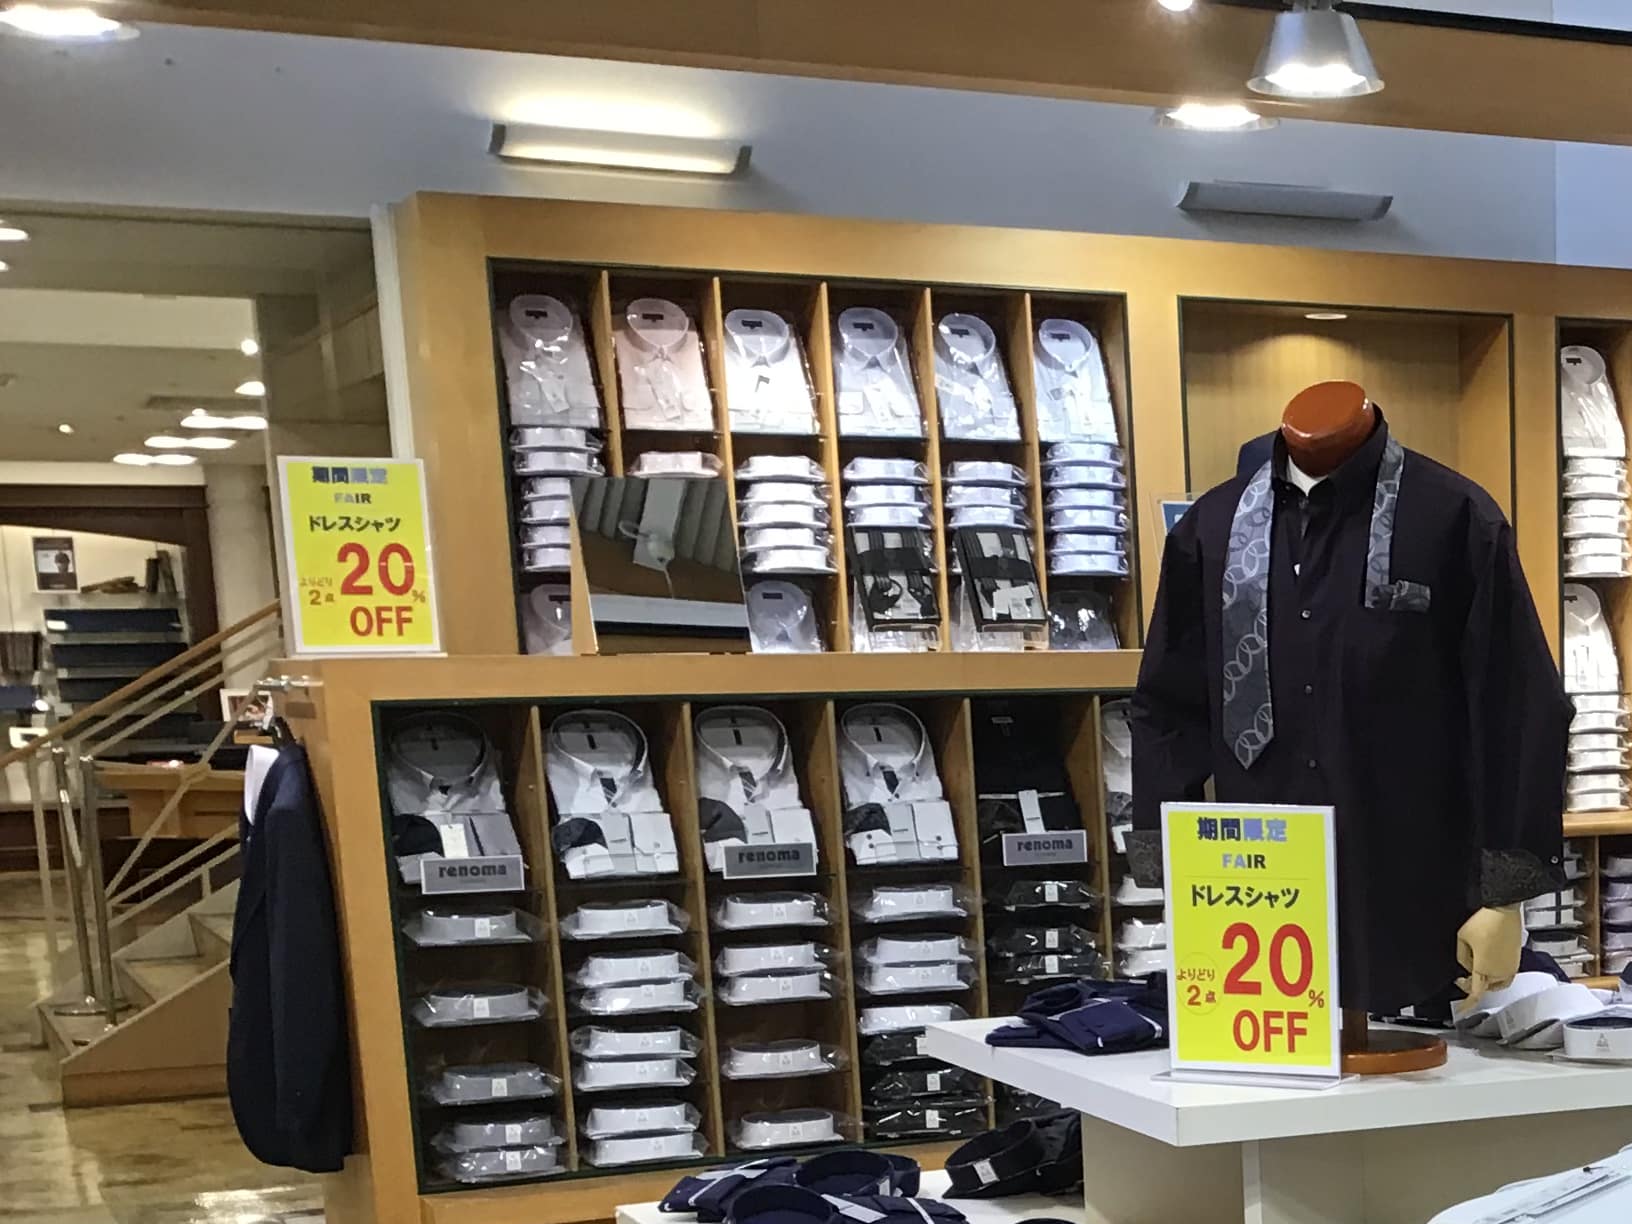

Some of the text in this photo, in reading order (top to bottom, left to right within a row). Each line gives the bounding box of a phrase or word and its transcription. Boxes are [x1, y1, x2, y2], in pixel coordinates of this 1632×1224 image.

[309, 515, 401, 533] ドレスシャツ
[350, 606, 413, 637] OFF
[1197, 817, 1287, 842] 期間限定
[1017, 838, 1073, 851] renoma
[738, 849, 800, 863] renoma
[1222, 854, 1266, 869] FAIR
[439, 864, 507, 878] renoma
[1191, 884, 1300, 909] ドレスシャツ
[1177, 968, 1216, 981] よりどり
[1233, 1009, 1309, 1053] OFF
